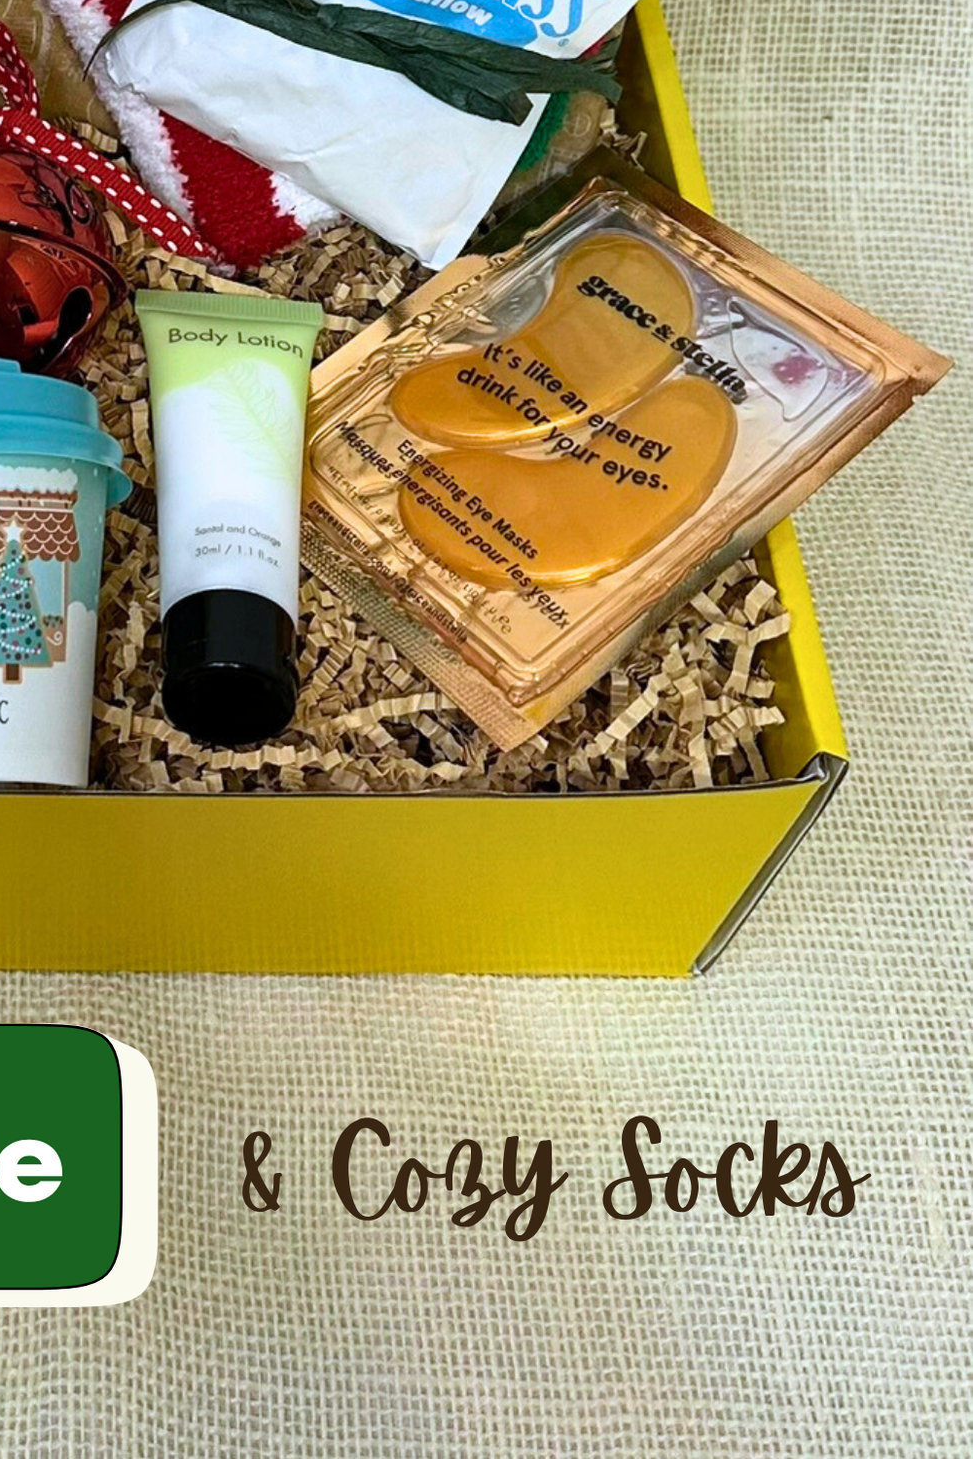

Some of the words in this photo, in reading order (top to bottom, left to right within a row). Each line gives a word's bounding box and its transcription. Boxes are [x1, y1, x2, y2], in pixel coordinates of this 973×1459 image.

[168, 328, 228, 346] Body
[237, 331, 304, 358] Lotion
[577, 275, 657, 330] grace
[651, 323, 676, 343] &
[670, 336, 747, 397] stella
[457, 367, 520, 406] drink
[515, 397, 552, 428] for
[543, 426, 600, 466] your
[602, 461, 669, 491] eyes.
[483, 343, 522, 369] It's
[524, 359, 563, 393] like
[560, 390, 589, 415] an
[588, 412, 672, 463] energy
[194, 543, 221, 558] 30ml
[238, 545, 253, 556] 1.1
[226, 525, 245, 534] and
[248, 527, 281, 547] Orange
[335, 420, 394, 476] Masques
[391, 467, 472, 537] énergisants
[467, 534, 509, 566] pour
[506, 562, 532, 588] les
[530, 584, 571, 625] yeux
[397, 439, 468, 503] Energizing
[465, 495, 493, 523] Eye
[492, 518, 539, 560] Masks
